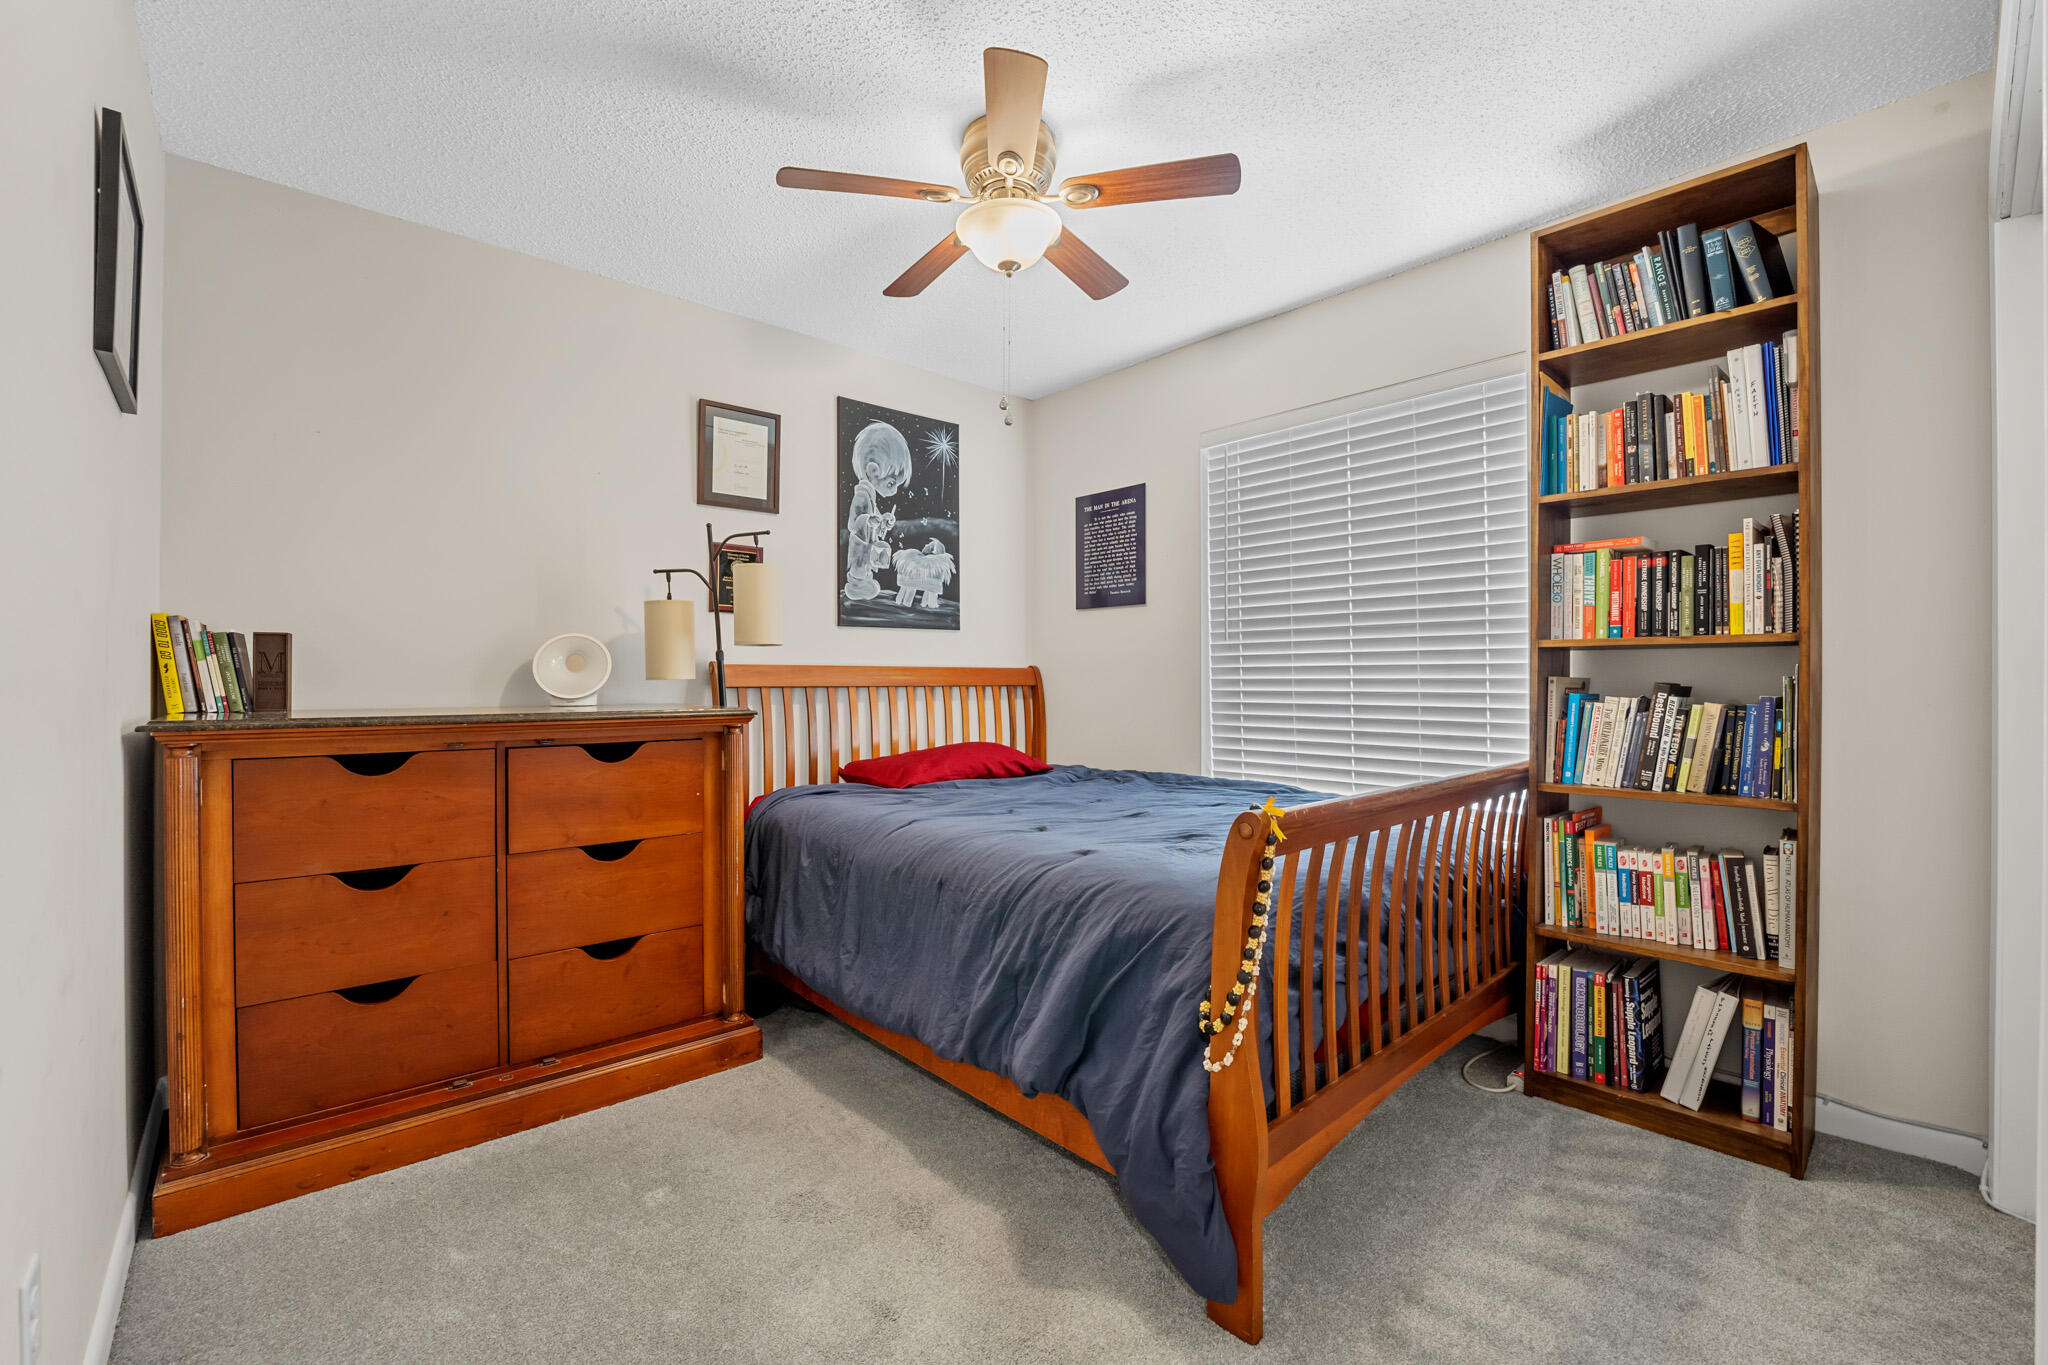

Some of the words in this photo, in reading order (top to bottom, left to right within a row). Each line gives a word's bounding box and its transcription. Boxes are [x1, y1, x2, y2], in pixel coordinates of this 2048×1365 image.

[1654, 257, 1666, 287] RANGE
[1552, 557, 1562, 603] WHOLE30
[1584, 575, 1595, 605] THRIVE
[154, 620, 168, 638] GOOD
[158, 640, 169, 648] TO
[160, 651, 172, 660] GO
[1649, 692, 1667, 739] Deskbound
[1667, 700, 1675, 718] READY
[1674, 714, 1684, 730] TIM
[1591, 721, 1599, 745] FINANCIAL
[1598, 721, 1612, 757] MILLIONAIRE
[1664, 724, 1672, 737] RUN
[1668, 732, 1681, 762] TEBOW
[1766, 859, 1777, 883] How
[1768, 888, 1778, 906] We
[1768, 908, 1779, 929] Die
[1575, 977, 1586, 1054] IMMUNOBIOLOGY
[1625, 1002, 1636, 1030] Supple
[1626, 1031, 1638, 1065] Leopard
[1764, 1048, 1773, 1080] Physiology
